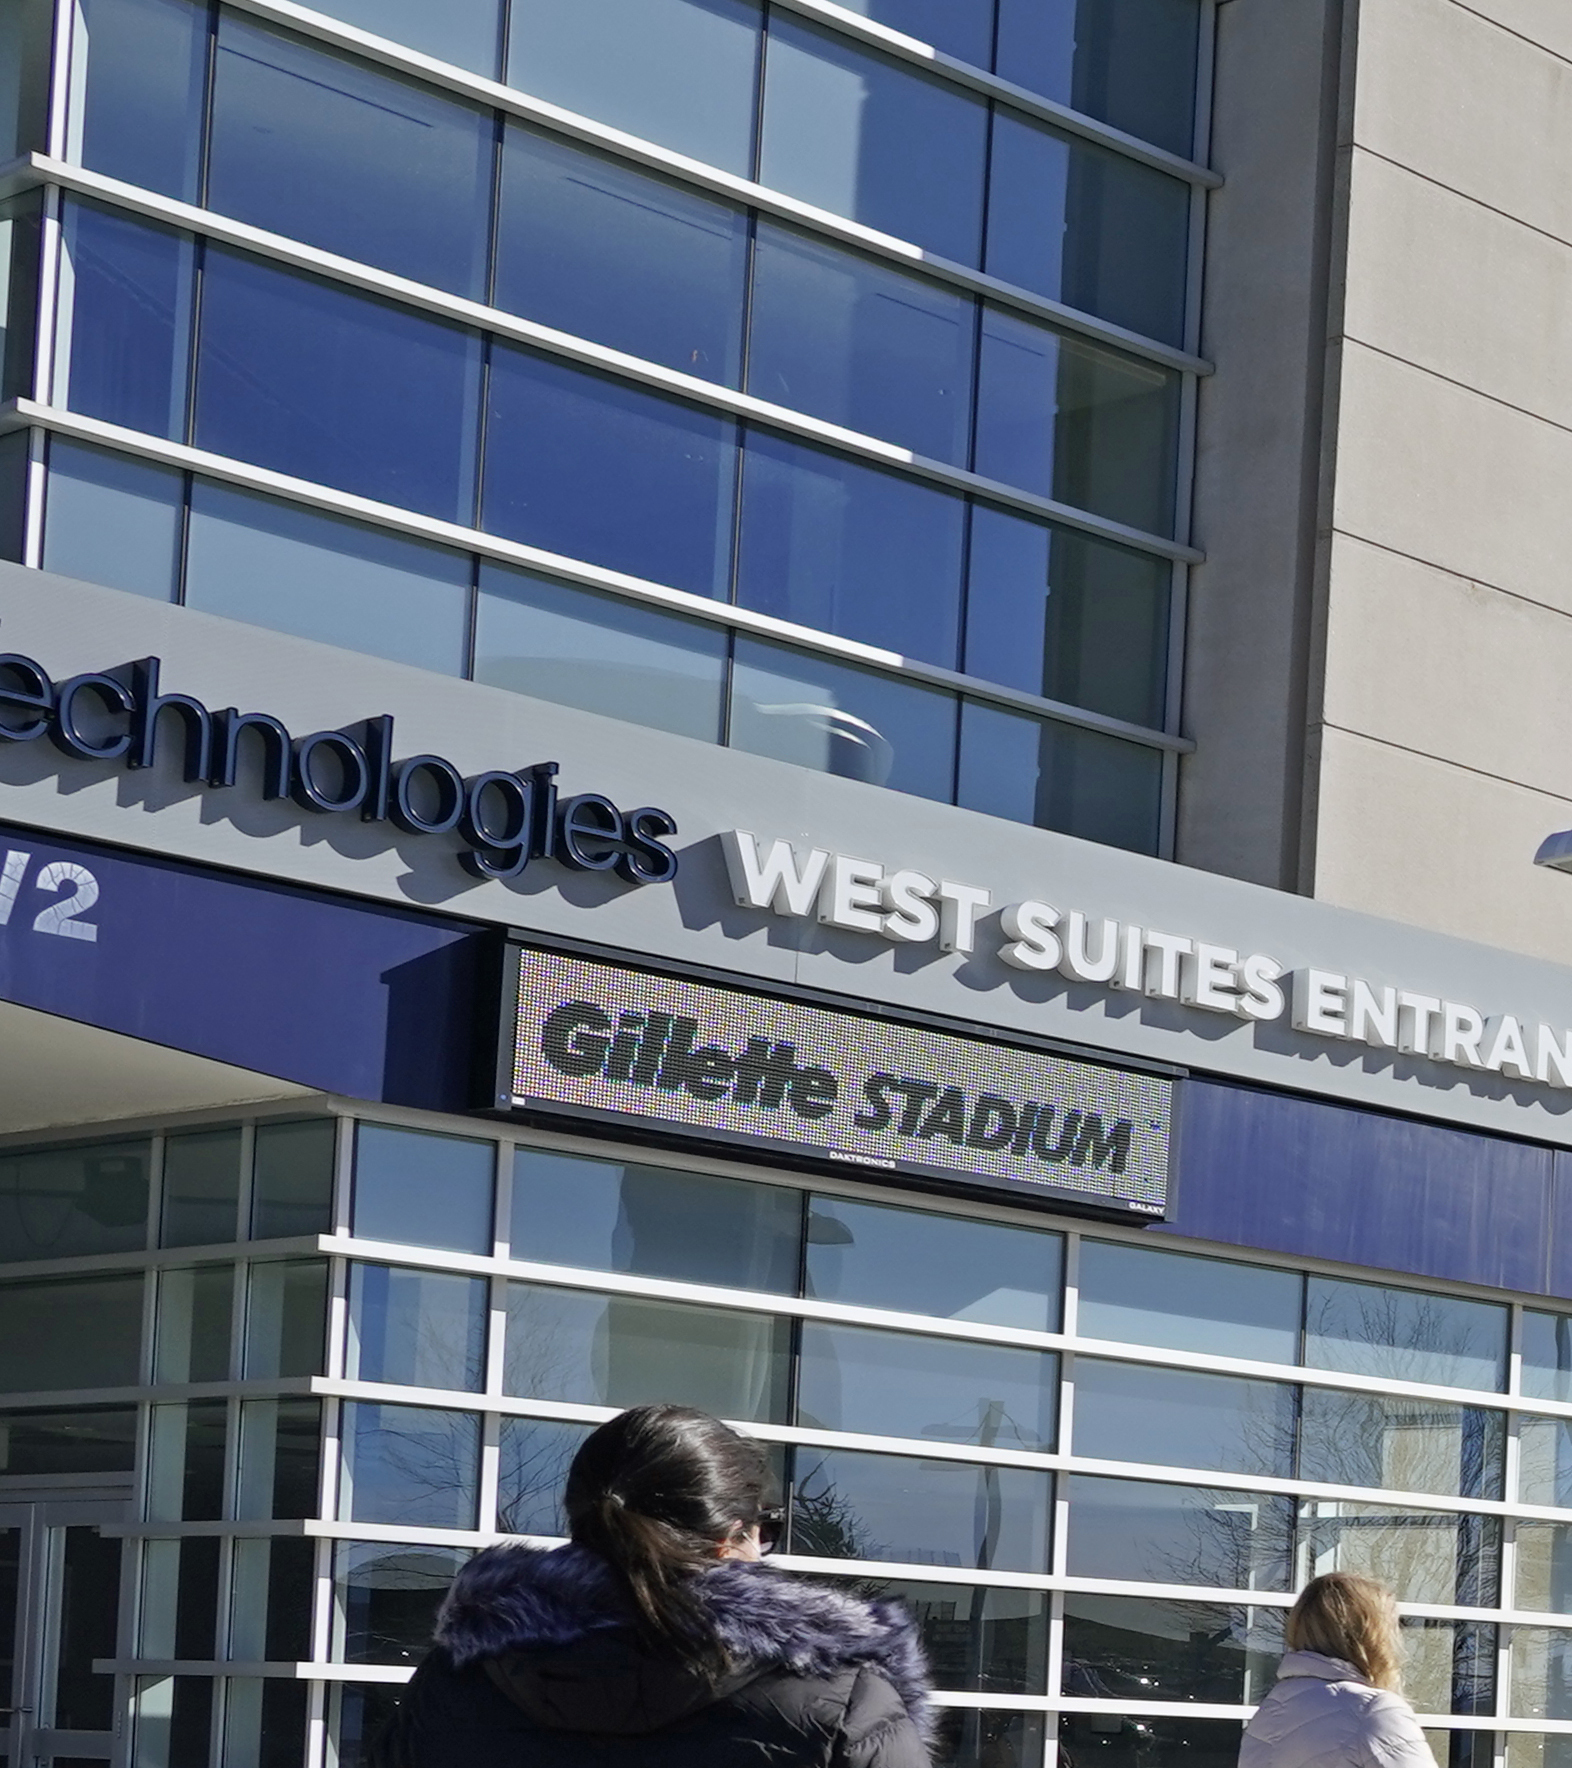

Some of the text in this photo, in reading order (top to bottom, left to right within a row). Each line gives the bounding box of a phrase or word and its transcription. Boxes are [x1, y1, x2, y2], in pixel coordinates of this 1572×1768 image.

[0, 652, 679, 886] echnologies
[721, 828, 992, 953] WEST
[999, 899, 1285, 1021] SUITES
[541, 1000, 1132, 1175] Gillette STADIUM
[829, 1151, 896, 1169] DAKTRONICS
[1128, 1202, 1165, 1216] GALAXY
